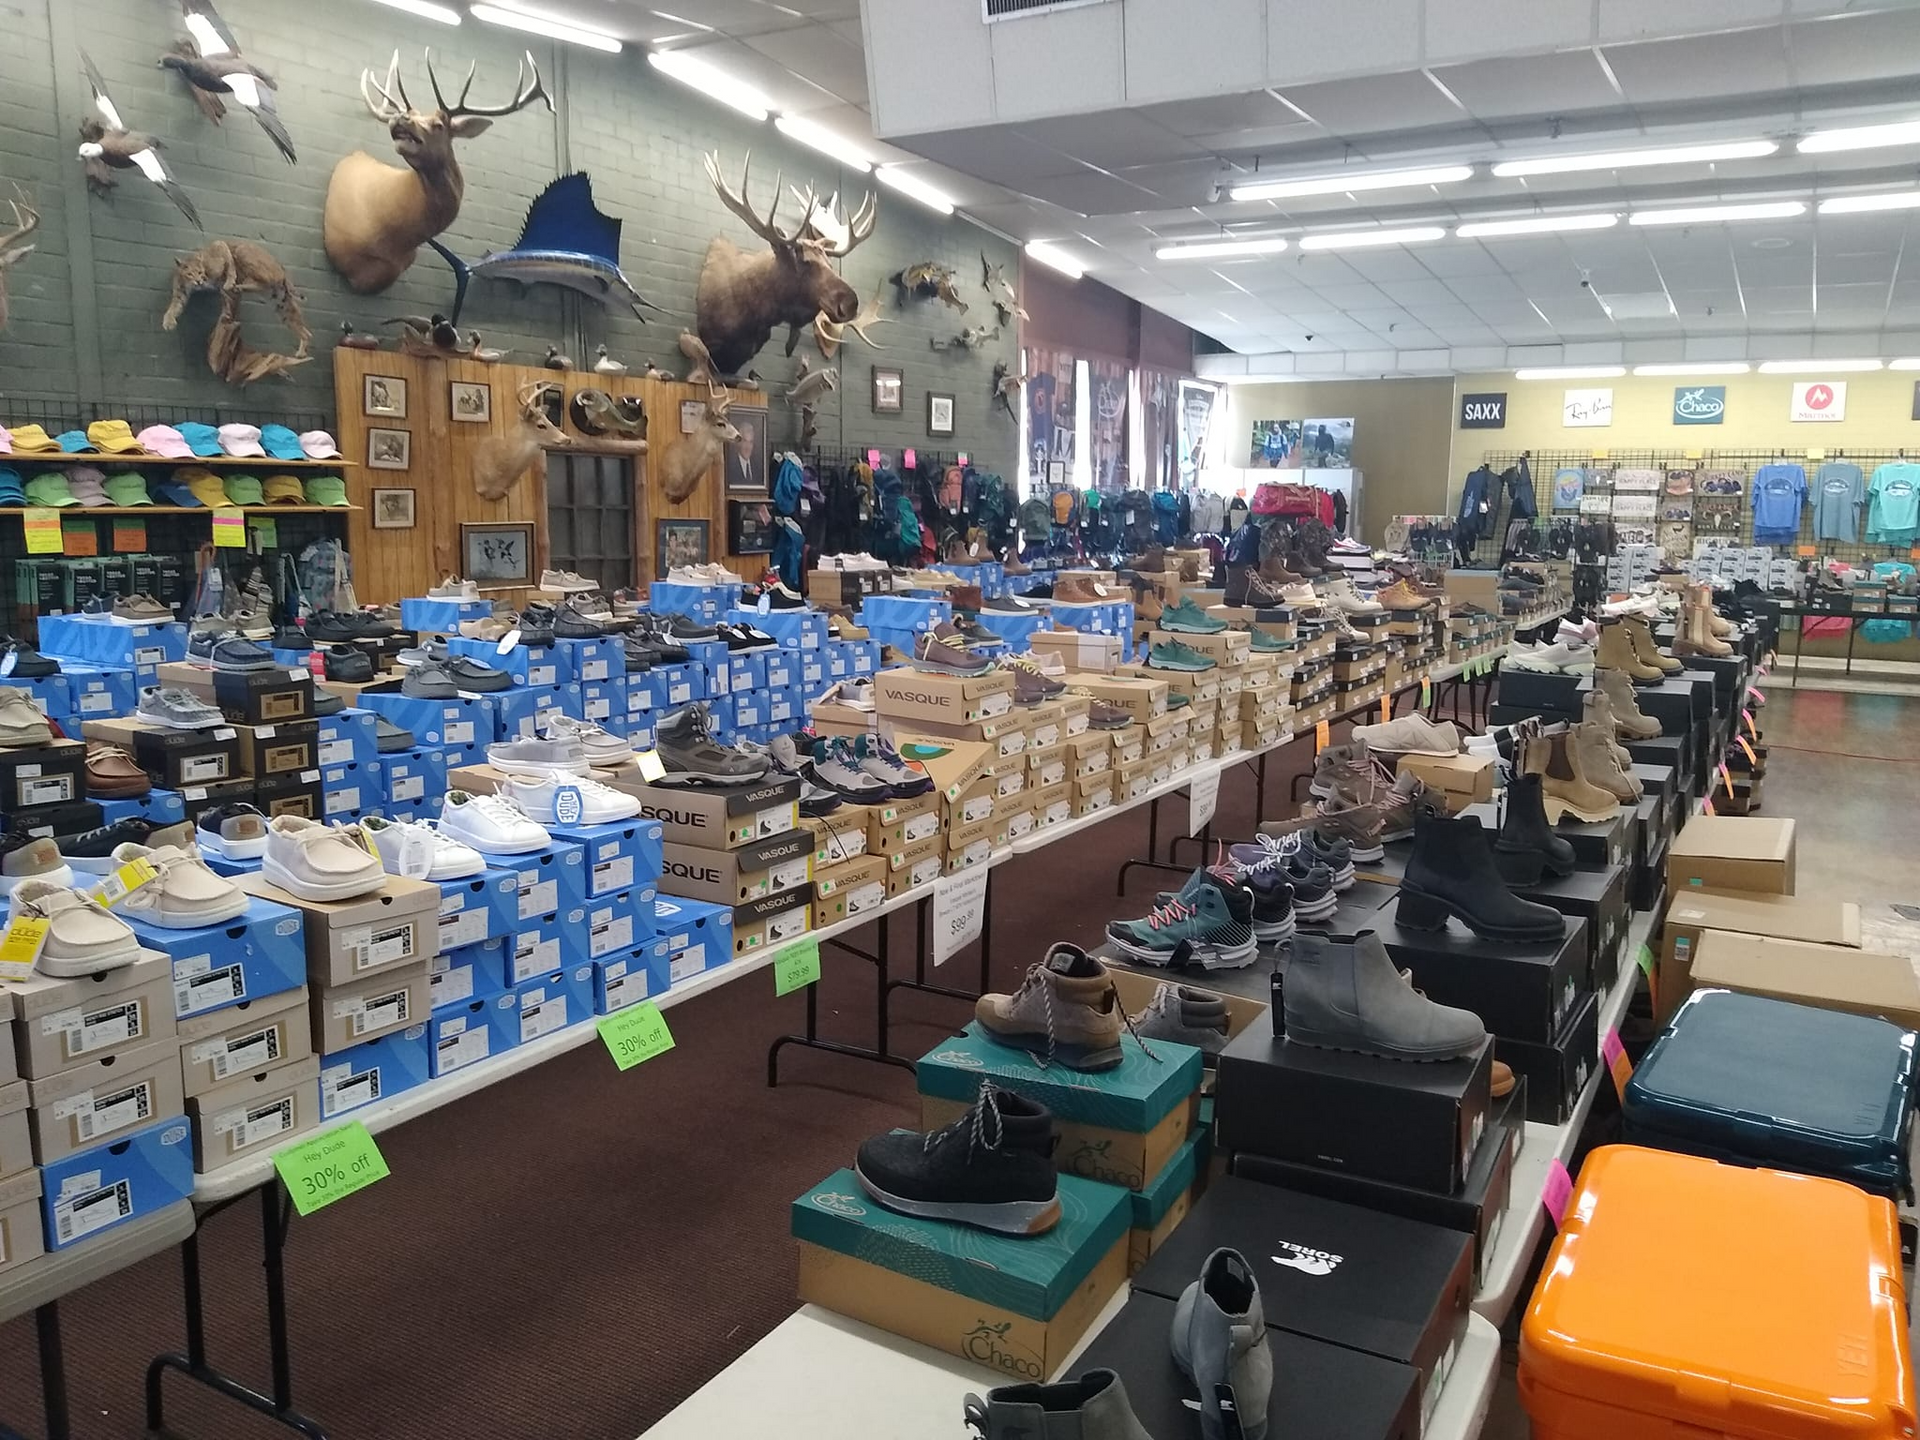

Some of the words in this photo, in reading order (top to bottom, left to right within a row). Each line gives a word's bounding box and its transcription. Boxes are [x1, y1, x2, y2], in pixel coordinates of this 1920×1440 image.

[1465, 403, 1501, 420] SAXX
[1679, 400, 1719, 413] Chaco
[976, 681, 1005, 693] VASQUE
[885, 689, 951, 707] VASQUE
[958, 762, 985, 787] VASQUE
[746, 785, 785, 802] VASQUE
[560, 794, 574, 821] DUDE
[570, 801, 578, 818] HEY
[896, 801, 926, 815] VASQUE
[816, 818, 853, 834] VASQUE
[958, 826, 985, 840] VASQUE
[757, 843, 800, 861] VASQUE
[835, 870, 870, 888] VASQUE
[754, 893, 796, 913] VASQUE
[617, 1034, 647, 1056] 30%
[649, 1028, 662, 1042] off
[303, 1152, 322, 1163] Hey
[322, 1140, 346, 1155] Dude
[301, 1164, 345, 1195] 30%
[351, 1153, 371, 1173] off
[1074, 1155, 1140, 1188] Chaco
[1278, 1239, 1344, 1264] SOREL
[967, 1336, 1042, 1378] Chaco
[1836, 1333, 1869, 1379] YETI
